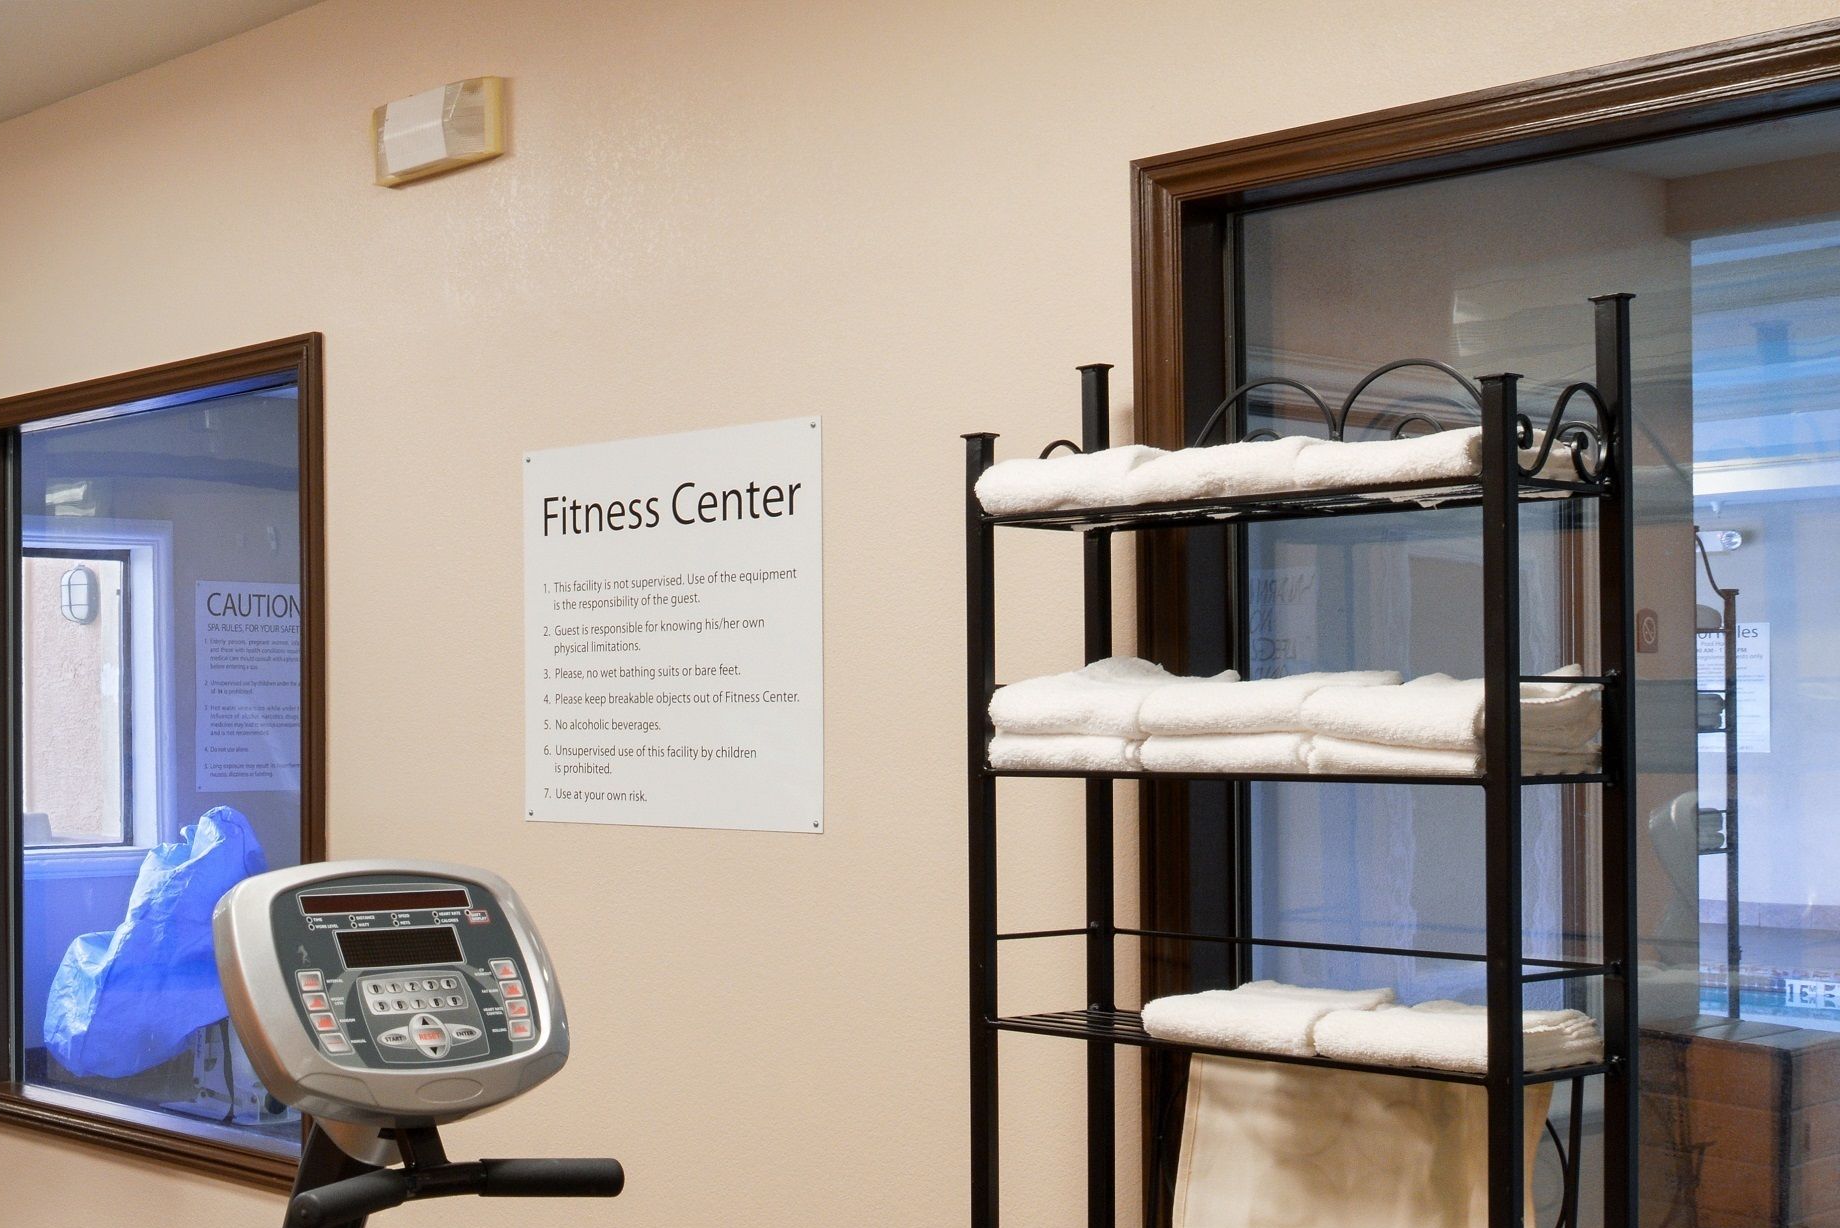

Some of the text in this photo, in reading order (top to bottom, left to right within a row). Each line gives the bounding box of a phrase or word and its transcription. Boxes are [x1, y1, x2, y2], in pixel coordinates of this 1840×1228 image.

[544, 481, 802, 536] Fitness Center
[543, 568, 797, 594] 1. This facility is not supervised. Use of the equipment
[208, 592, 300, 618] CAUTION
[553, 593, 700, 611] is the responsibility of the guest.
[208, 624, 220, 632] SPA
[245, 624, 260, 632] FOR
[260, 624, 280, 632] YOUR
[280, 625, 300, 634] SAFET
[543, 617, 765, 637] 2. Guest is responsible for knowing his/her own
[554, 640, 640, 656] physical limitations.
[543, 664, 741, 680] 3. Please, no wet bathing suits or bare feet.
[543, 690, 800, 706] 4. Please keep breakable objects out of Fitness Center.
[544, 718, 661, 733] 5. No alcoholic beverages.
[544, 745, 756, 760] 6. Unsupervised use of this facility by children
[554, 762, 612, 776] is prohibited.
[544, 788, 648, 802] 7. Use at your own risk.
[372, 984, 378, 993] 0
[392, 984, 396, 992] 1
[428, 981, 434, 989] 3
[446, 980, 451, 988] 4
[379, 997, 458, 1010] 5 6 7 8 9
[418, 1032, 440, 1040] RESET
